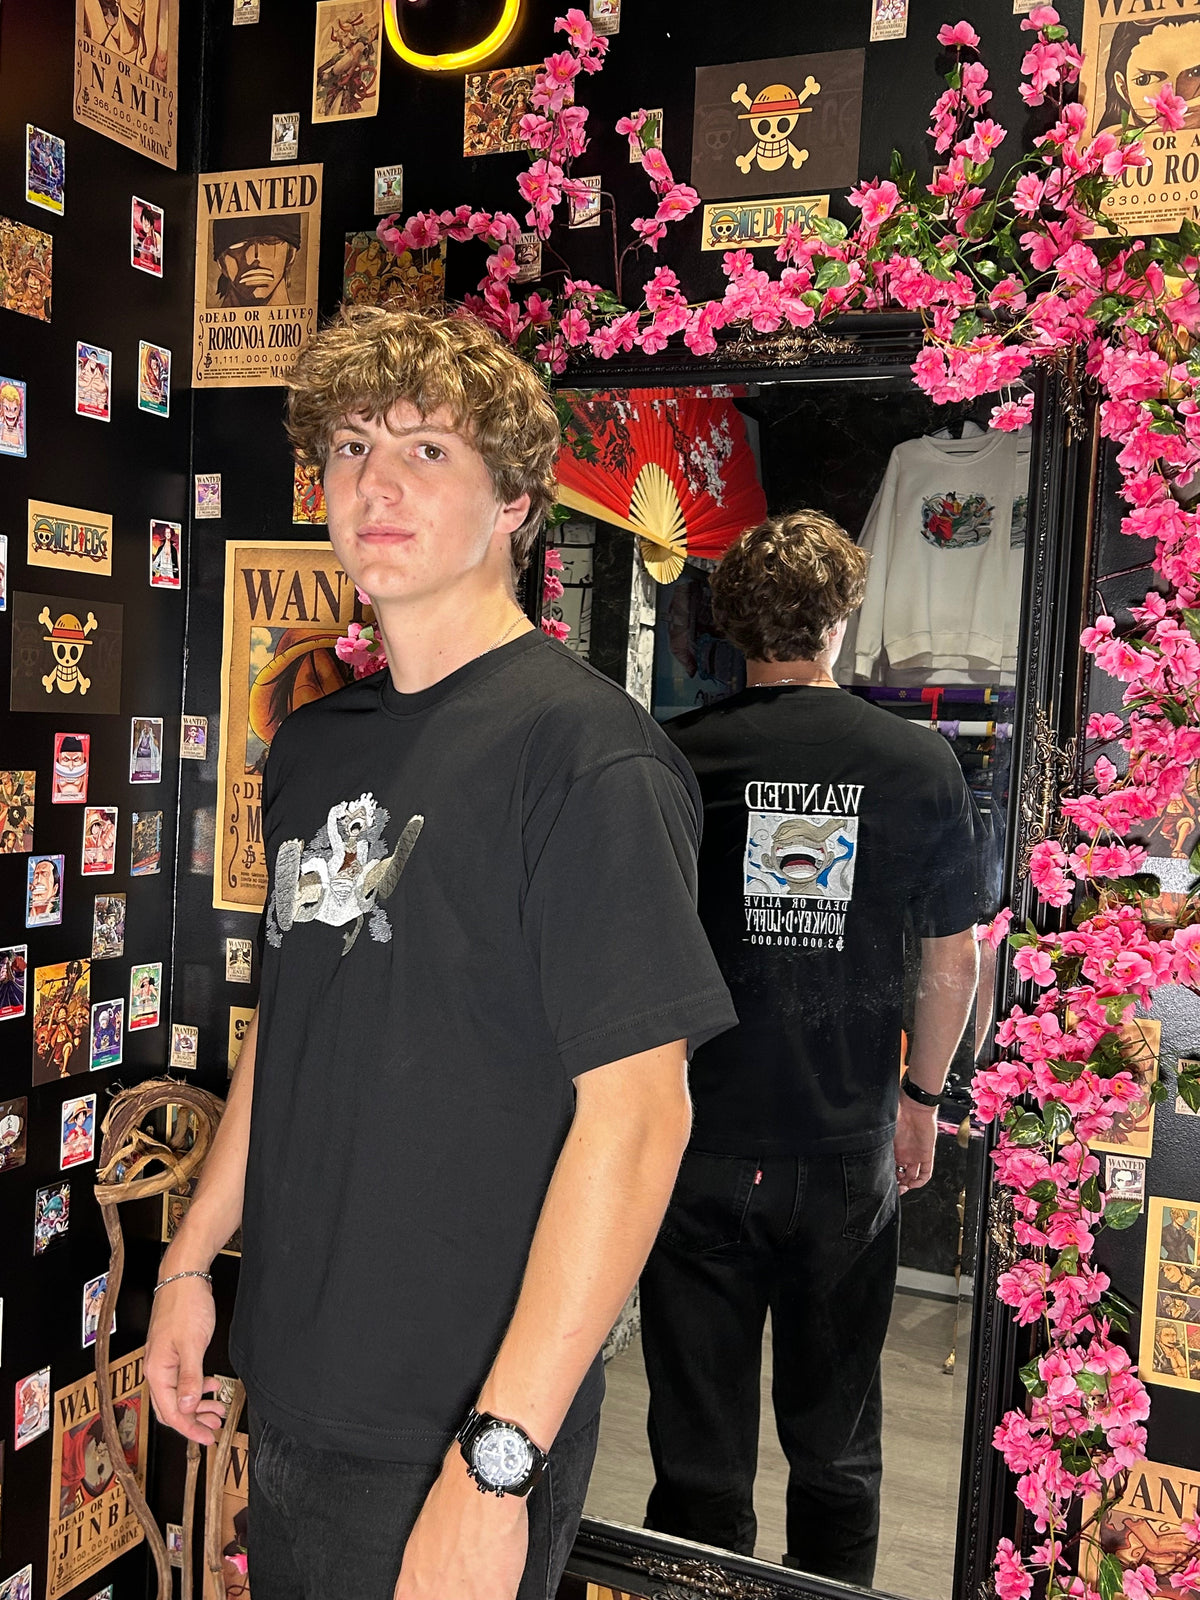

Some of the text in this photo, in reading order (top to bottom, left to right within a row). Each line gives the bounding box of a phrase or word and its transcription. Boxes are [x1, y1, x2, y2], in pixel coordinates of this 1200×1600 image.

[83, 39, 167, 99] DEAD OR ALIVE
[91, 60, 160, 123] NAMI
[275, 115, 299, 124] WANTED
[139, 134, 170, 159] MARINE
[1152, 136, 1176, 150] OR
[376, 167, 402, 177] WANTED
[203, 174, 317, 215] WANTED
[205, 308, 306, 323] DEAD OR ALIVE
[208, 323, 301, 351] RORONOA ZORO
[197, 476, 220, 484] WANTED
[229, 940, 252, 949] WANTED
[174, 1026, 198, 1036] WANTED
[1108, 1158, 1144, 1170] WANTED
[58, 1498, 103, 1535] DEAD OR
[110, 1525, 138, 1552] MARINE
